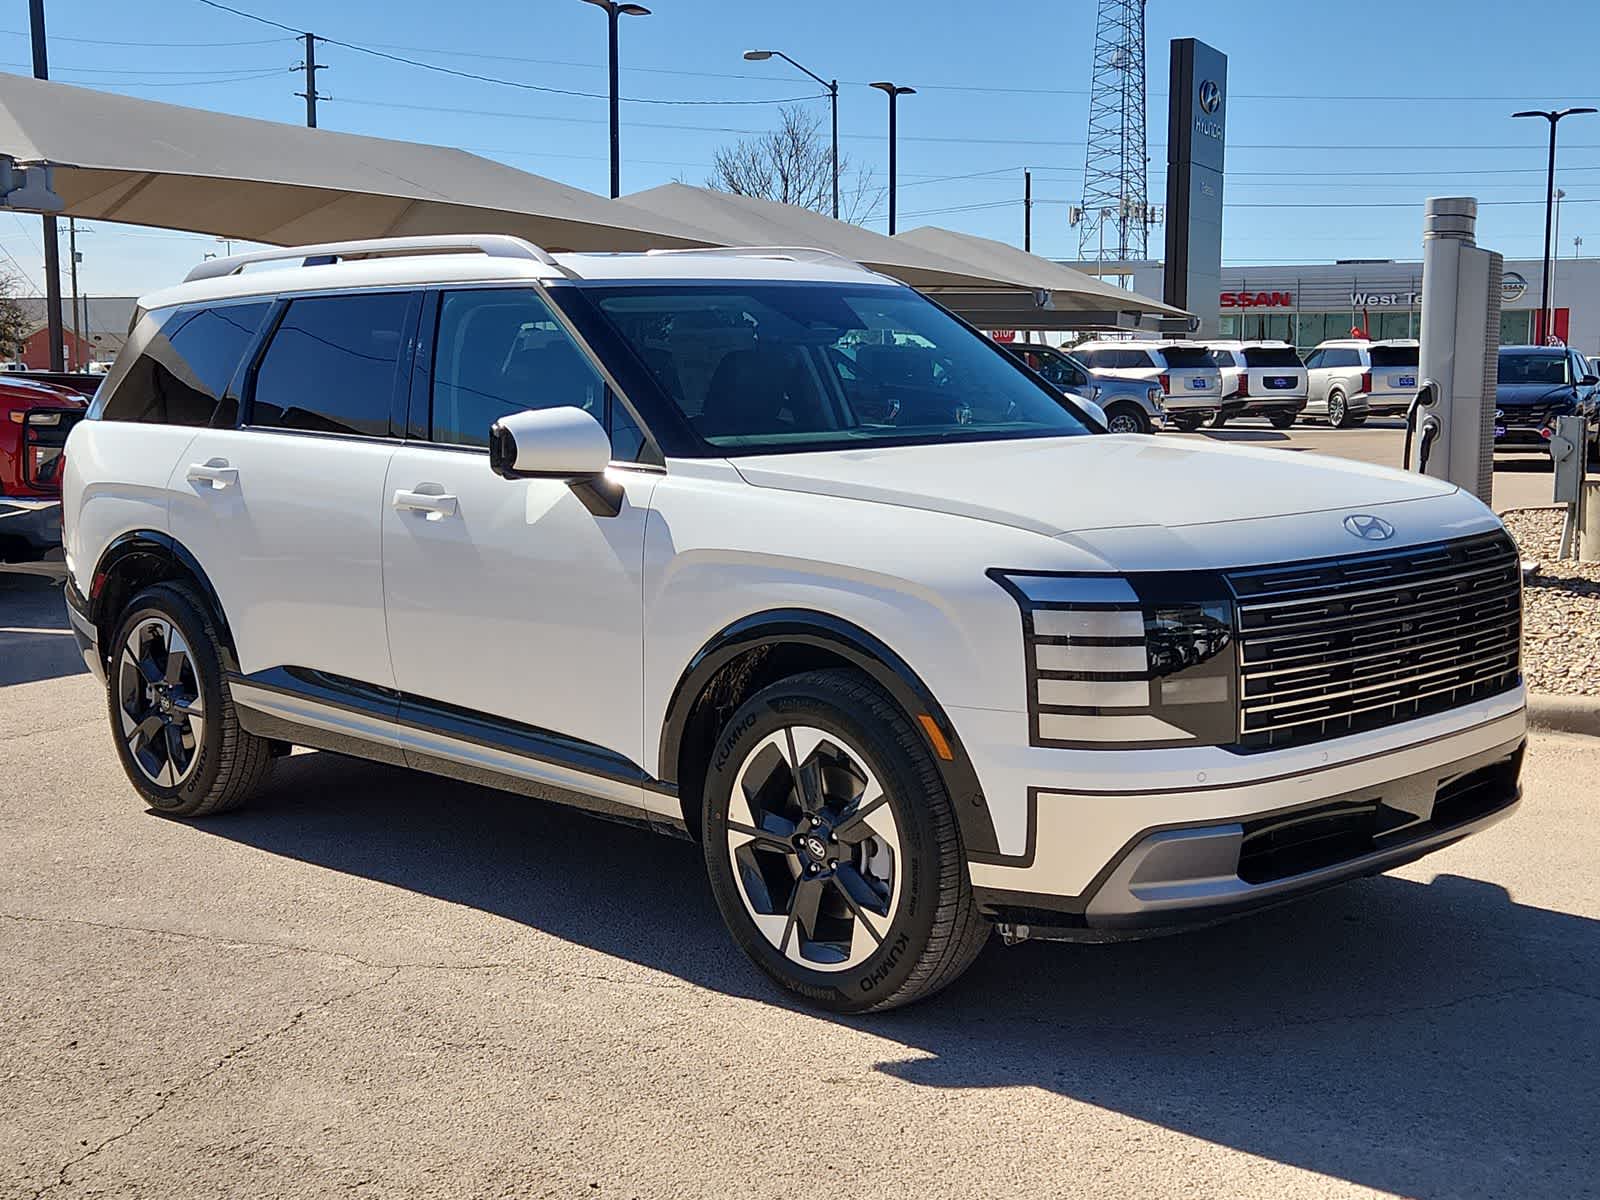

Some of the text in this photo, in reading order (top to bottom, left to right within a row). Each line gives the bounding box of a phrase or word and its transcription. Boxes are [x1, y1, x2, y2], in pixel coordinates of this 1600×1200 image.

[1350, 293, 1397, 306] West
[993, 328, 1015, 338] STOP
[714, 712, 756, 772] KUMHO
[860, 932, 910, 993] KUMHO
